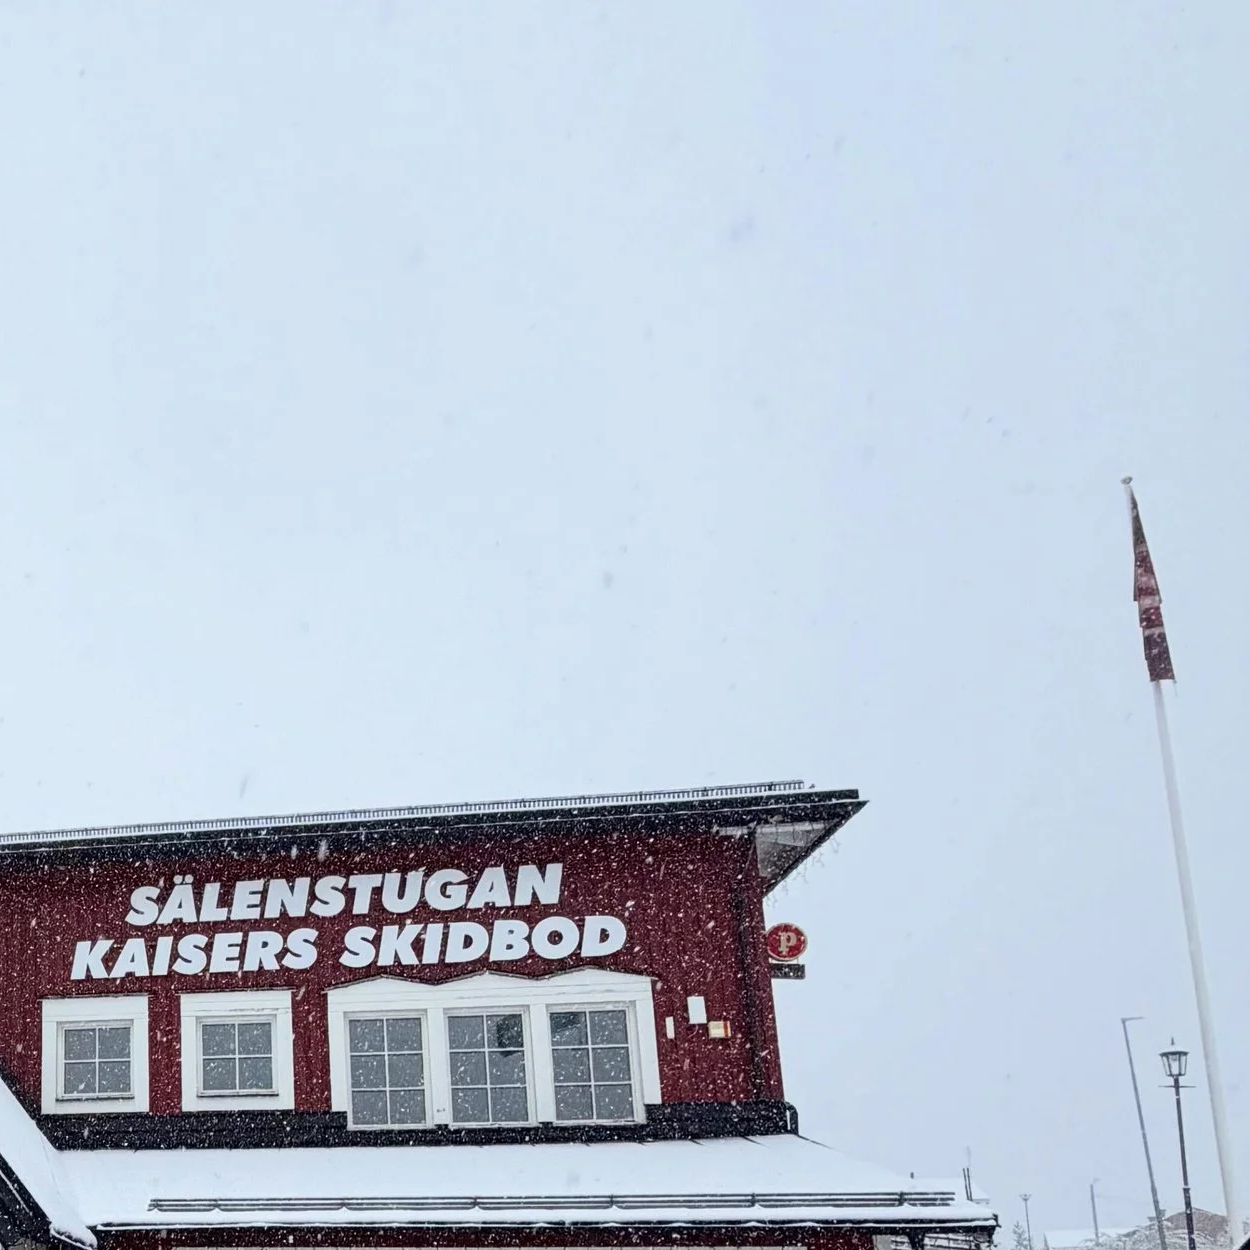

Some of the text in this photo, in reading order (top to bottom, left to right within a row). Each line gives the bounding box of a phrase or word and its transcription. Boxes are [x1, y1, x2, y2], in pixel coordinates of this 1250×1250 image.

[126, 864, 563, 926] SÄLENSTUGAN
[70, 916, 627, 980] KAISERS SKIDBOD
